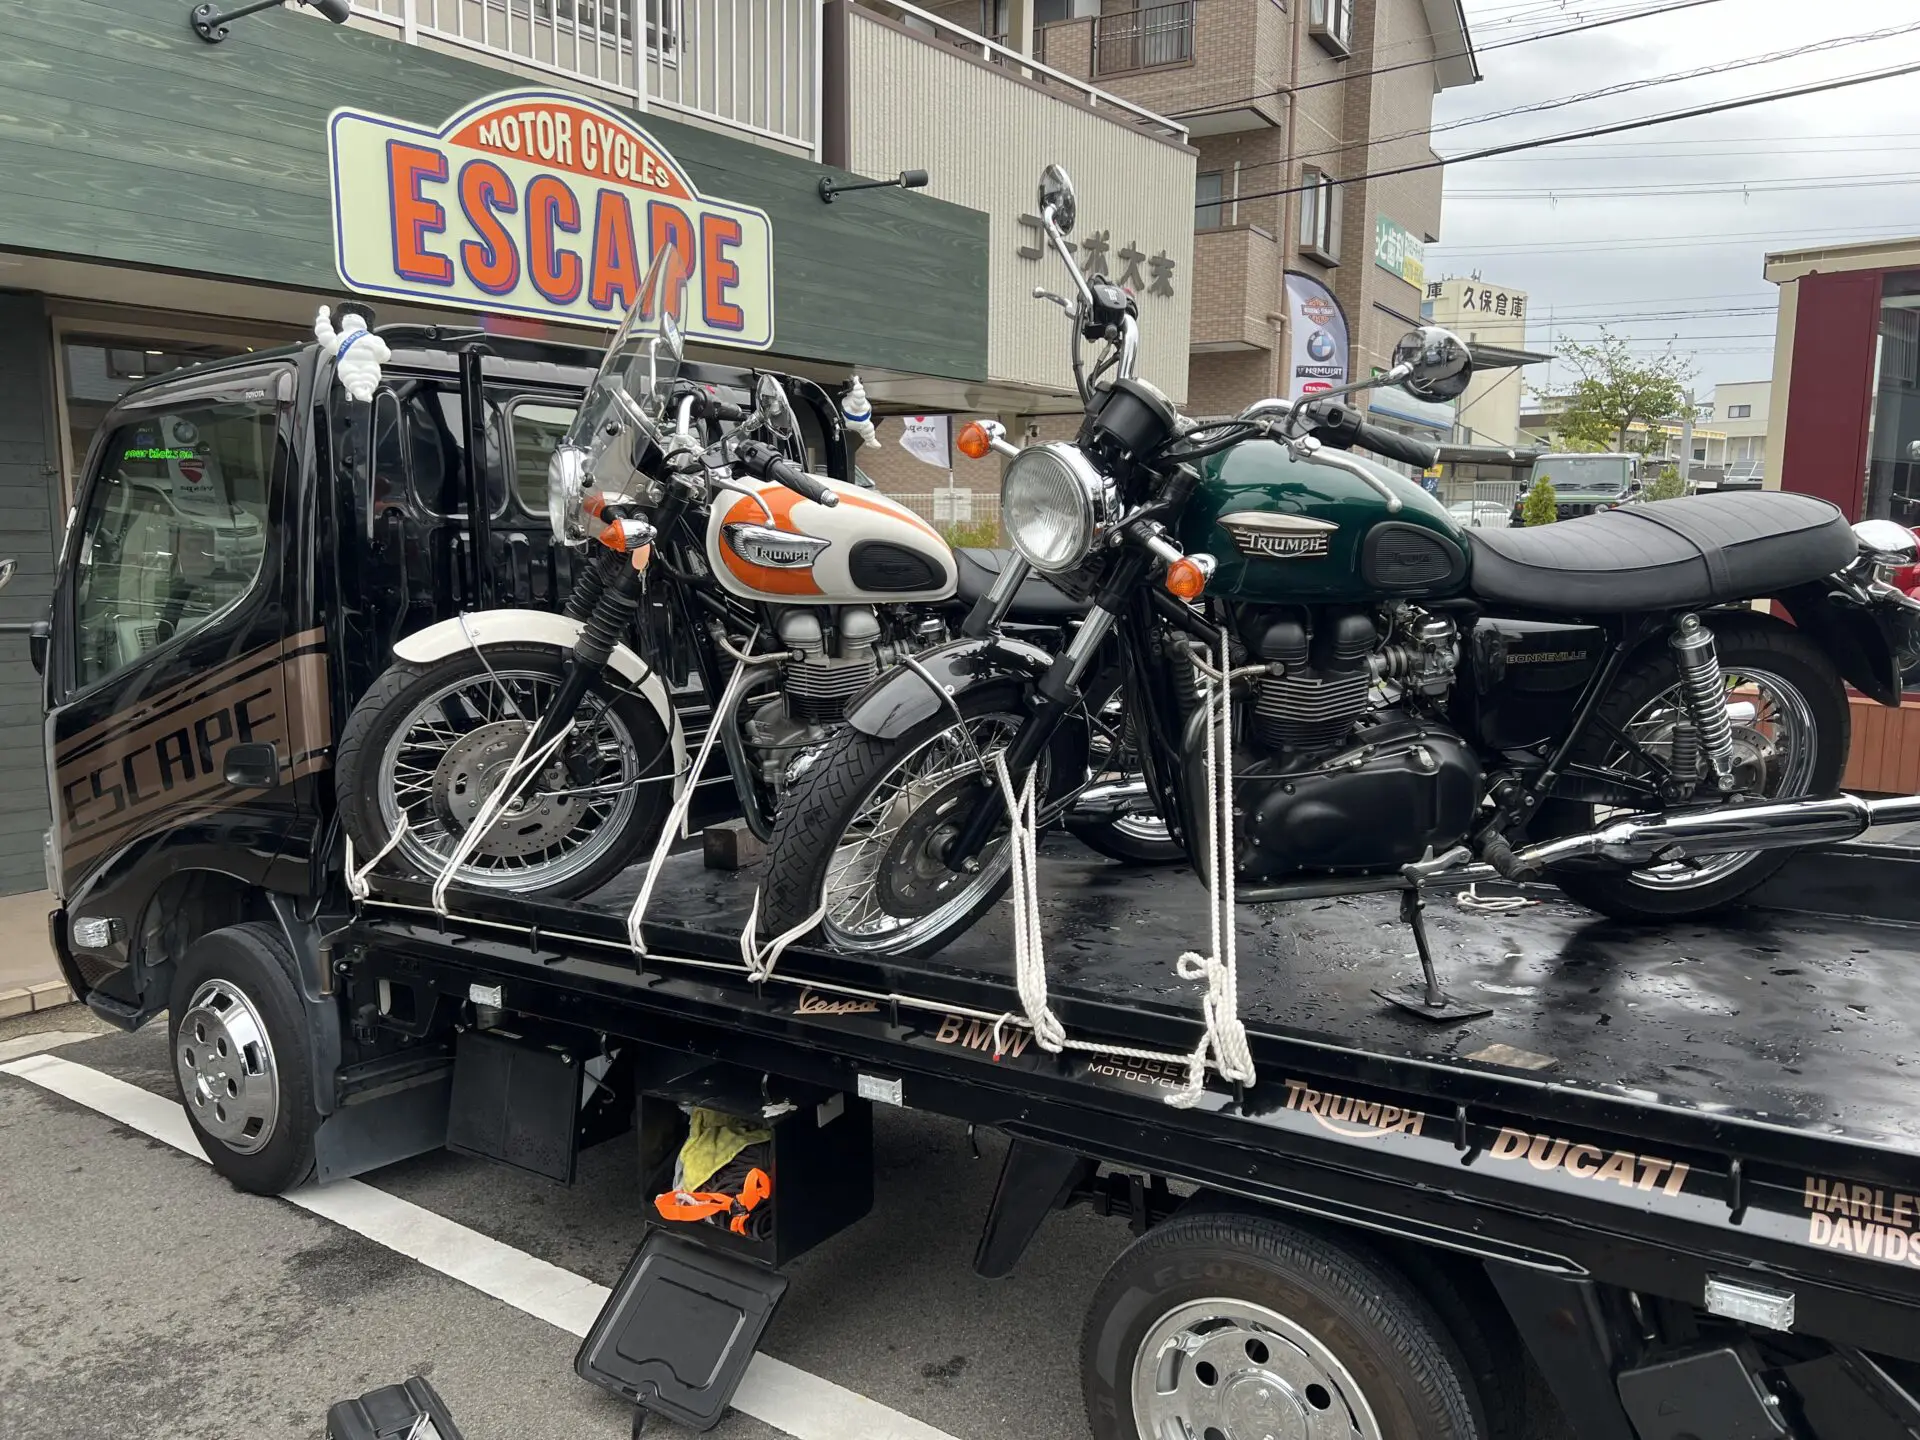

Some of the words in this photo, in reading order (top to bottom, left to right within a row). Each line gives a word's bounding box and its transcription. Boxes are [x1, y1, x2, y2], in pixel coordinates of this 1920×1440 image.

[479, 110, 573, 166] MOTOR
[581, 116, 672, 189] CYCLES
[387, 138, 744, 333] ESCAPE
[1463, 286, 1524, 319] 久保倉庫
[752, 545, 810, 566] TRIUMPH
[1248, 532, 1321, 558] TRIUMPH
[1506, 650, 1587, 664] BONNEVILLE
[63, 687, 282, 834] ESCAPE
[792, 985, 881, 1016] Vespa
[935, 1013, 1034, 1059] BMW
[1088, 1062, 1207, 1096] MOTOCYCLE
[1282, 1079, 1426, 1138] TRIUMPH
[1489, 1126, 1691, 1198] DUCATI
